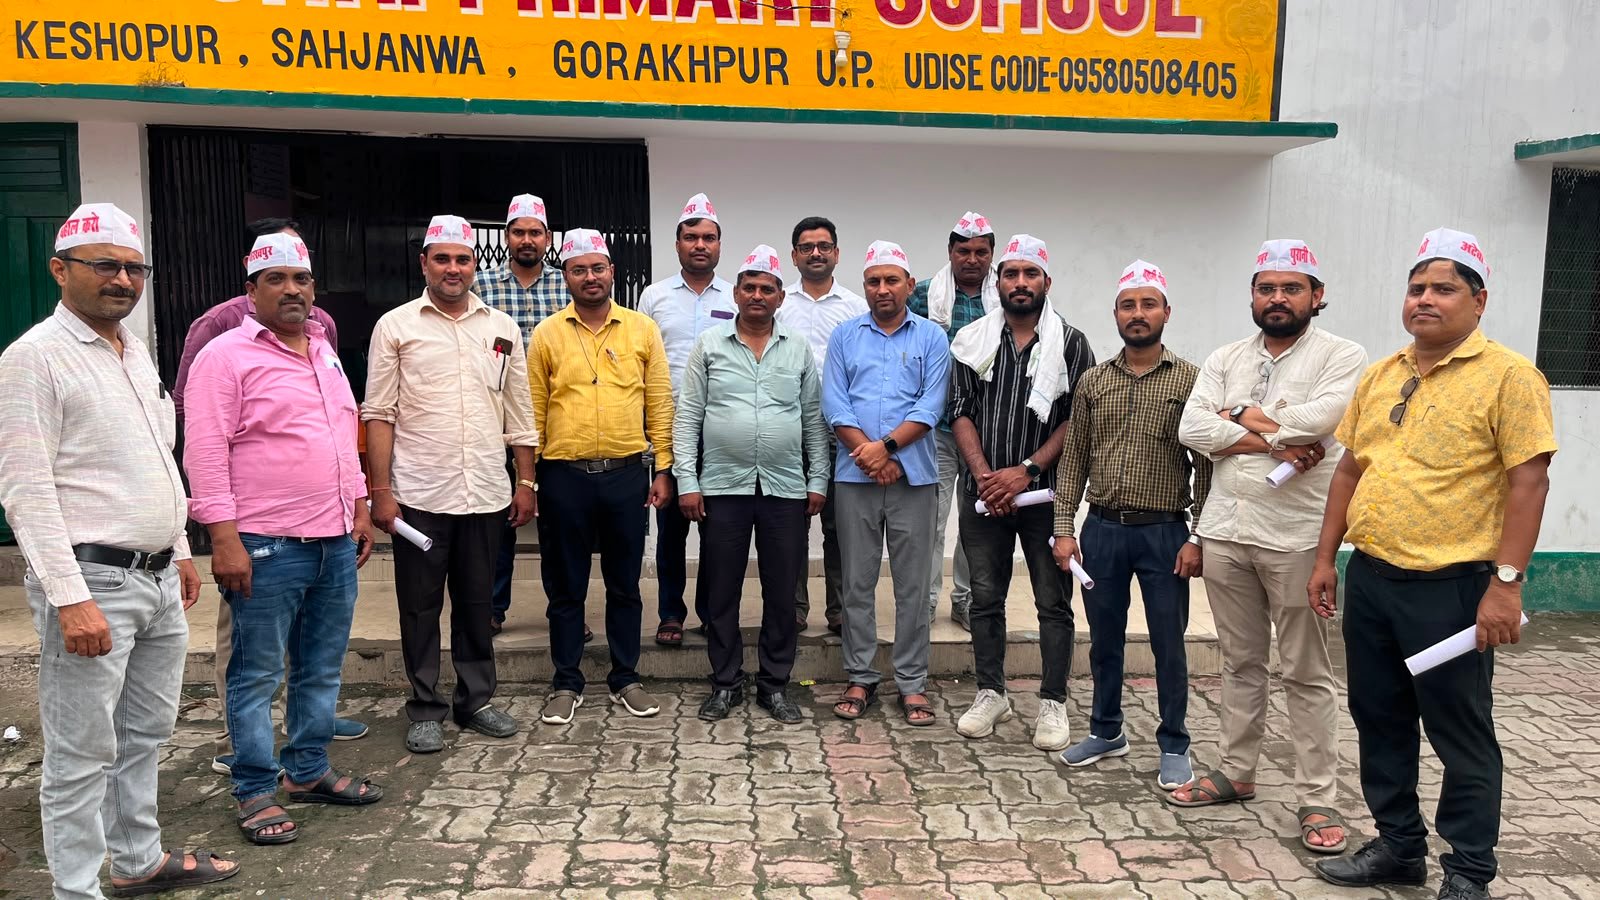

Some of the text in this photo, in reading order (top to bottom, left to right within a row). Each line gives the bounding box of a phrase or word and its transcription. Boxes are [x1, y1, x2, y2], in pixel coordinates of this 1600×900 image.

[15, 20, 221, 65] KESHOPUR
[271, 27, 486, 76] SAHJANWA
[553, 39, 789, 86] GORAKHPUR
[816, 49, 875, 89] U.P.
[904, 52, 984, 91] UDISE
[990, 54, 1237, 100] CODE-09580508405
